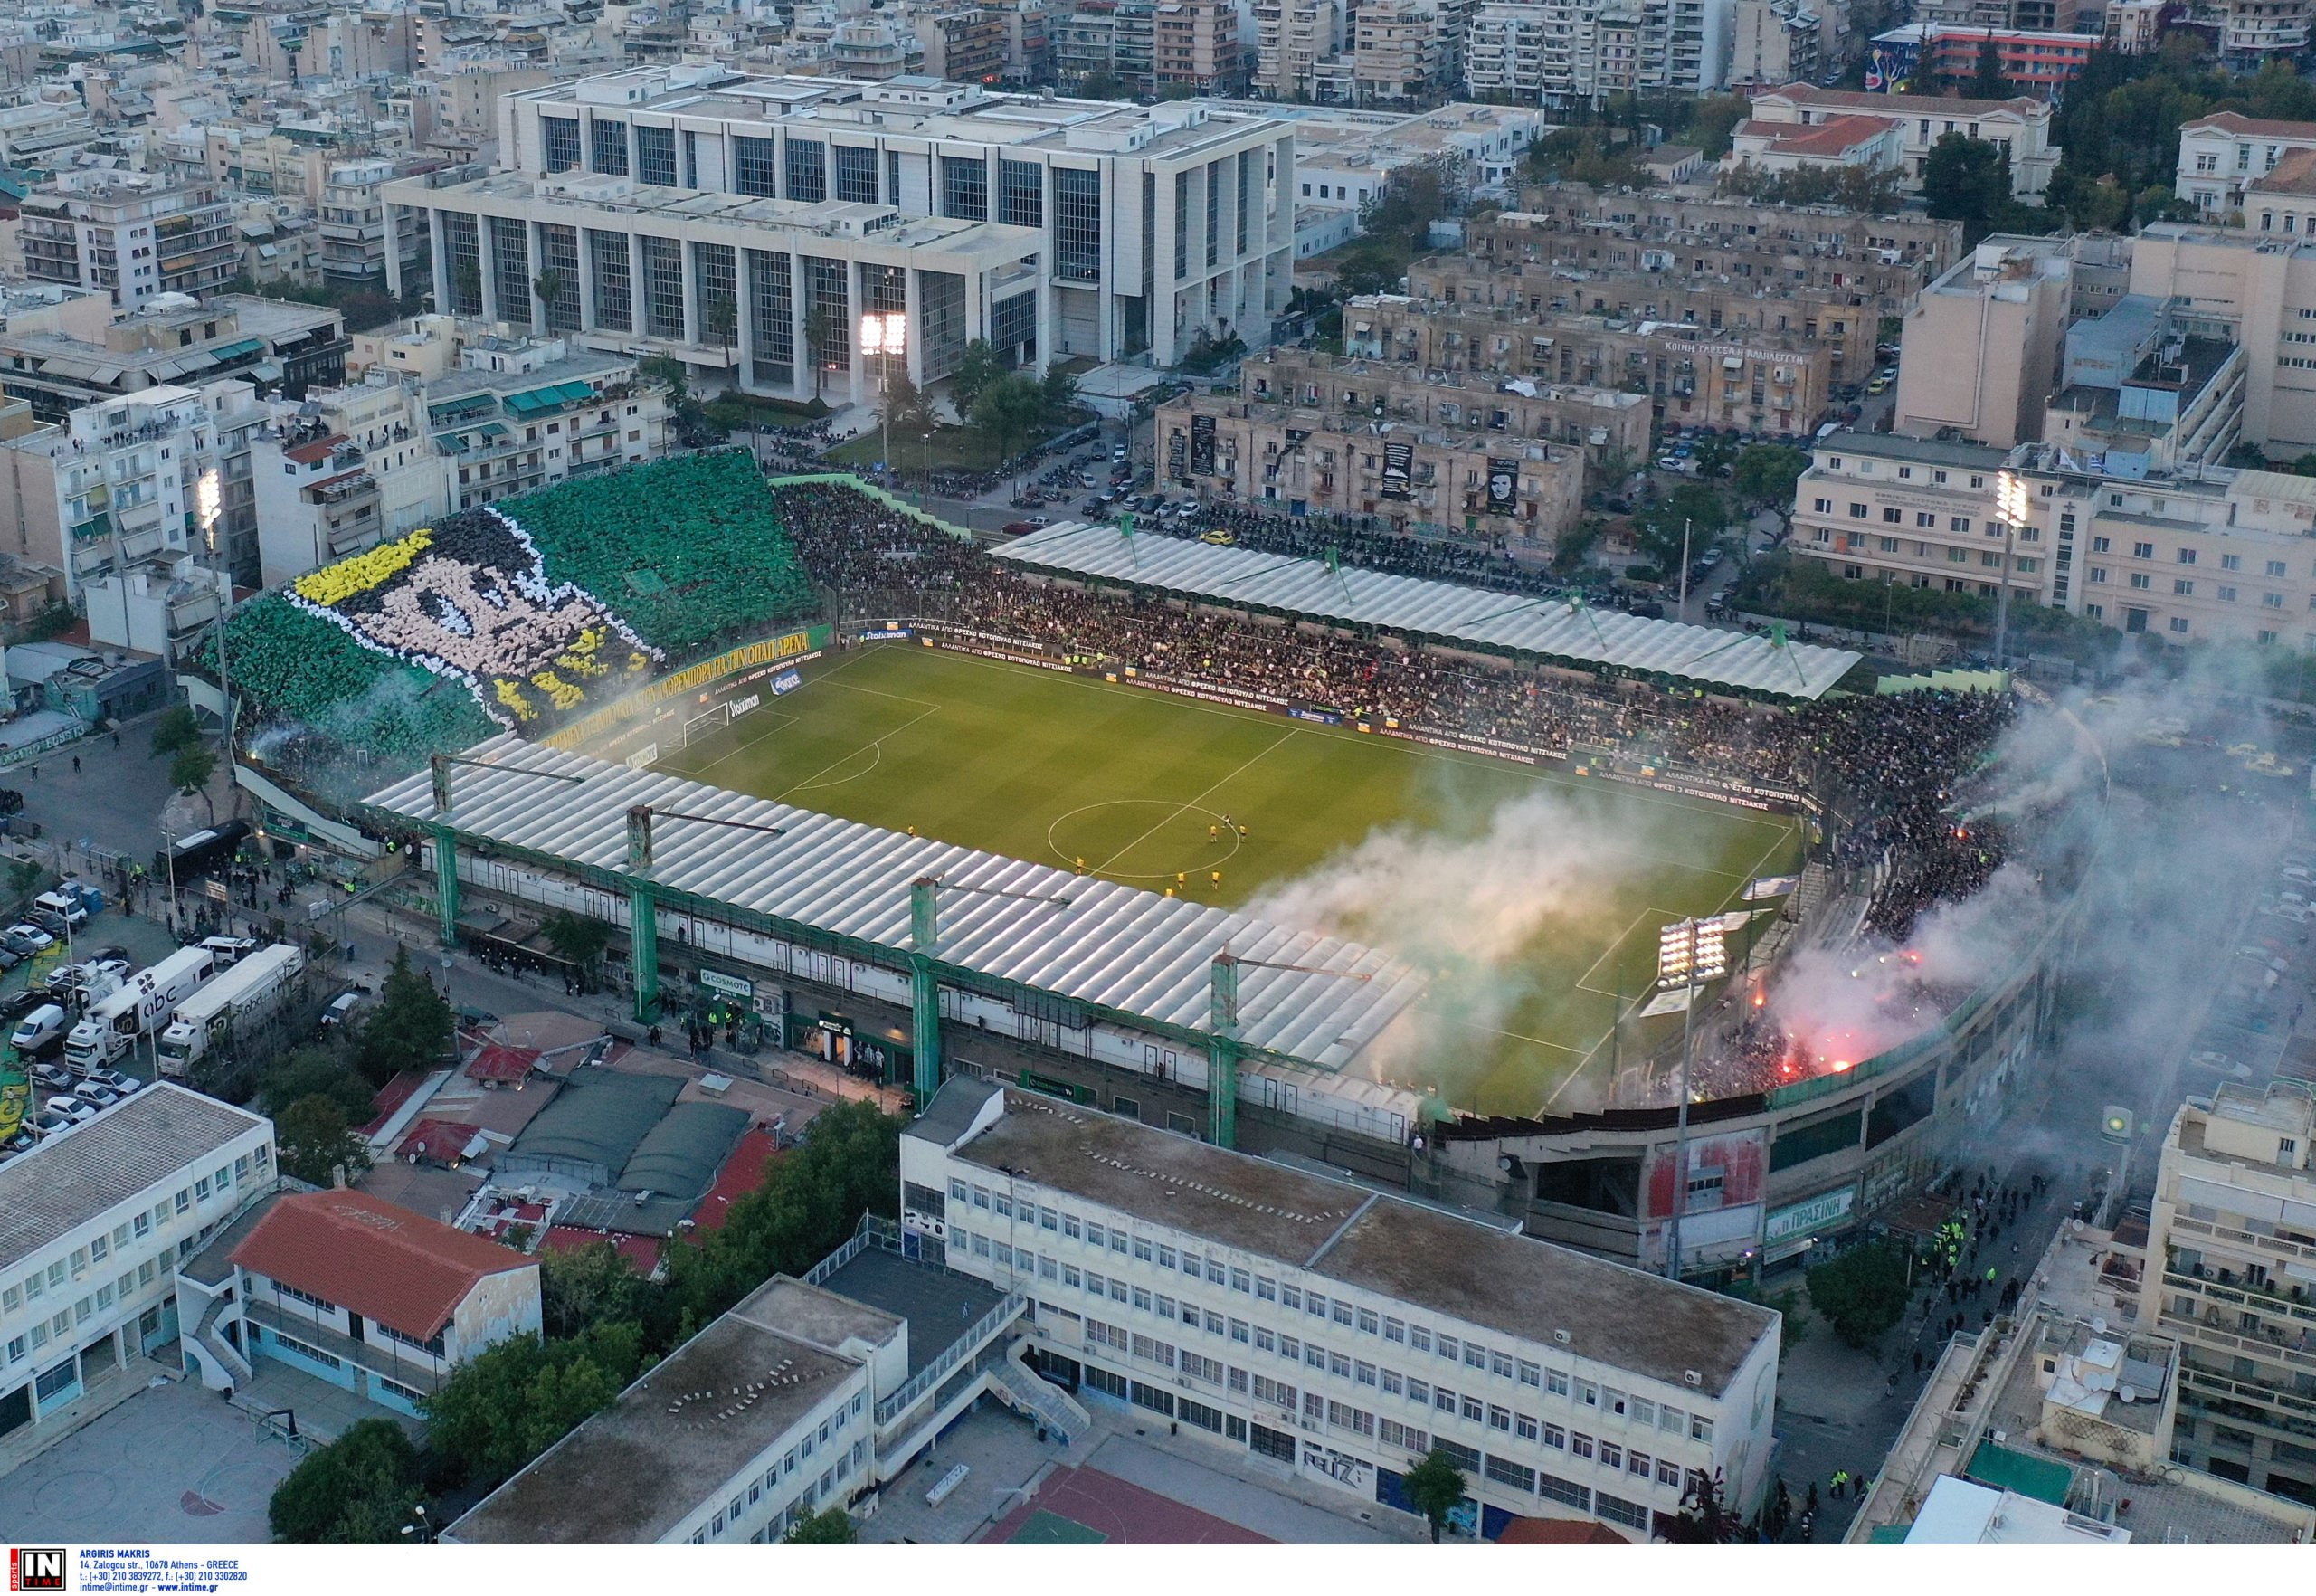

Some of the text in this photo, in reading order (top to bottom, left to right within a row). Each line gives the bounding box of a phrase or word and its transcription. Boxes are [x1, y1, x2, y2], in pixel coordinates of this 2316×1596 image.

[729, 648, 747, 670] ΤΗΝ
[747, 641, 775, 666] ΟΠΑΠ
[778, 632, 809, 658] ΑΡΕΝΑ
[865, 630, 906, 641] Stoiximan
[908, 622, 939, 632] ΑΛΛΑΝΤΙΚΑ
[941, 624, 953, 632] ΑΠΟ
[979, 632, 1011, 644] ΚΟΤΟΠΟΥΛΟ
[1013, 639, 1043, 650] ΝΙΤΣΙΑΚΟΣ
[941, 642, 970, 652] ΑΛΛΑΝΤΙΚΑ
[972, 646, 982, 655] ΑΠΟ
[1008, 654, 1040, 666] ΚΟΤΟΠΟΥΛΟ
[1042, 660, 1073, 672] ΝΙΤΣΙΑΚΟΣ
[1125, 679, 1156, 691] ΑΛΛΑΝΤΙΚΑ
[1158, 684, 1169, 693] ΑΠΟ
[1197, 692, 1232, 704] ΚΟΤΟΠΟΥΛΟ
[1234, 698, 1267, 711] ΝΙΤΣΙΑΚΟΣ
[1145, 671, 1176, 684] ΑΛΛΑΝΤΙΚΑ
[1178, 678, 1190, 687] ΑΠΟ
[1218, 686, 1254, 698] ΚΟΤΟΠΟΥΛΟ
[1256, 693, 1288, 706] ΝΙΤΣΙΑΚΟΣ
[729, 694, 760, 718] Stoiximan
[1379, 728, 1413, 741] ΑΛΛΑΝΤΙΚΑ
[1415, 735, 1428, 744] ΑΠΟ
[1458, 743, 1497, 756] ΚΟΤΟΠΟΥΛΟ
[1499, 751, 1534, 765] ΝΙΤΣΙΑΚΟΣ
[1408, 724, 1443, 736] ΑΛΛΑΝΤΙΚΑ
[1445, 730, 1457, 738] ΑΠΟ
[1489, 738, 1529, 753] ΚΟΤΟΠΟΥΛΟ
[1531, 747, 1567, 760] ΝΙΤΣΙΑΚΟΣ
[1730, 796, 1769, 811] ΝΙΤΣΙΑΚΟΣ
[1753, 787, 1799, 802] ΚΟΤΟΠΟΥΛΟ
[144, 986, 176, 1019] abc
[1792, 1197, 1840, 1229] ΠΡΑΣΙΝΗ
